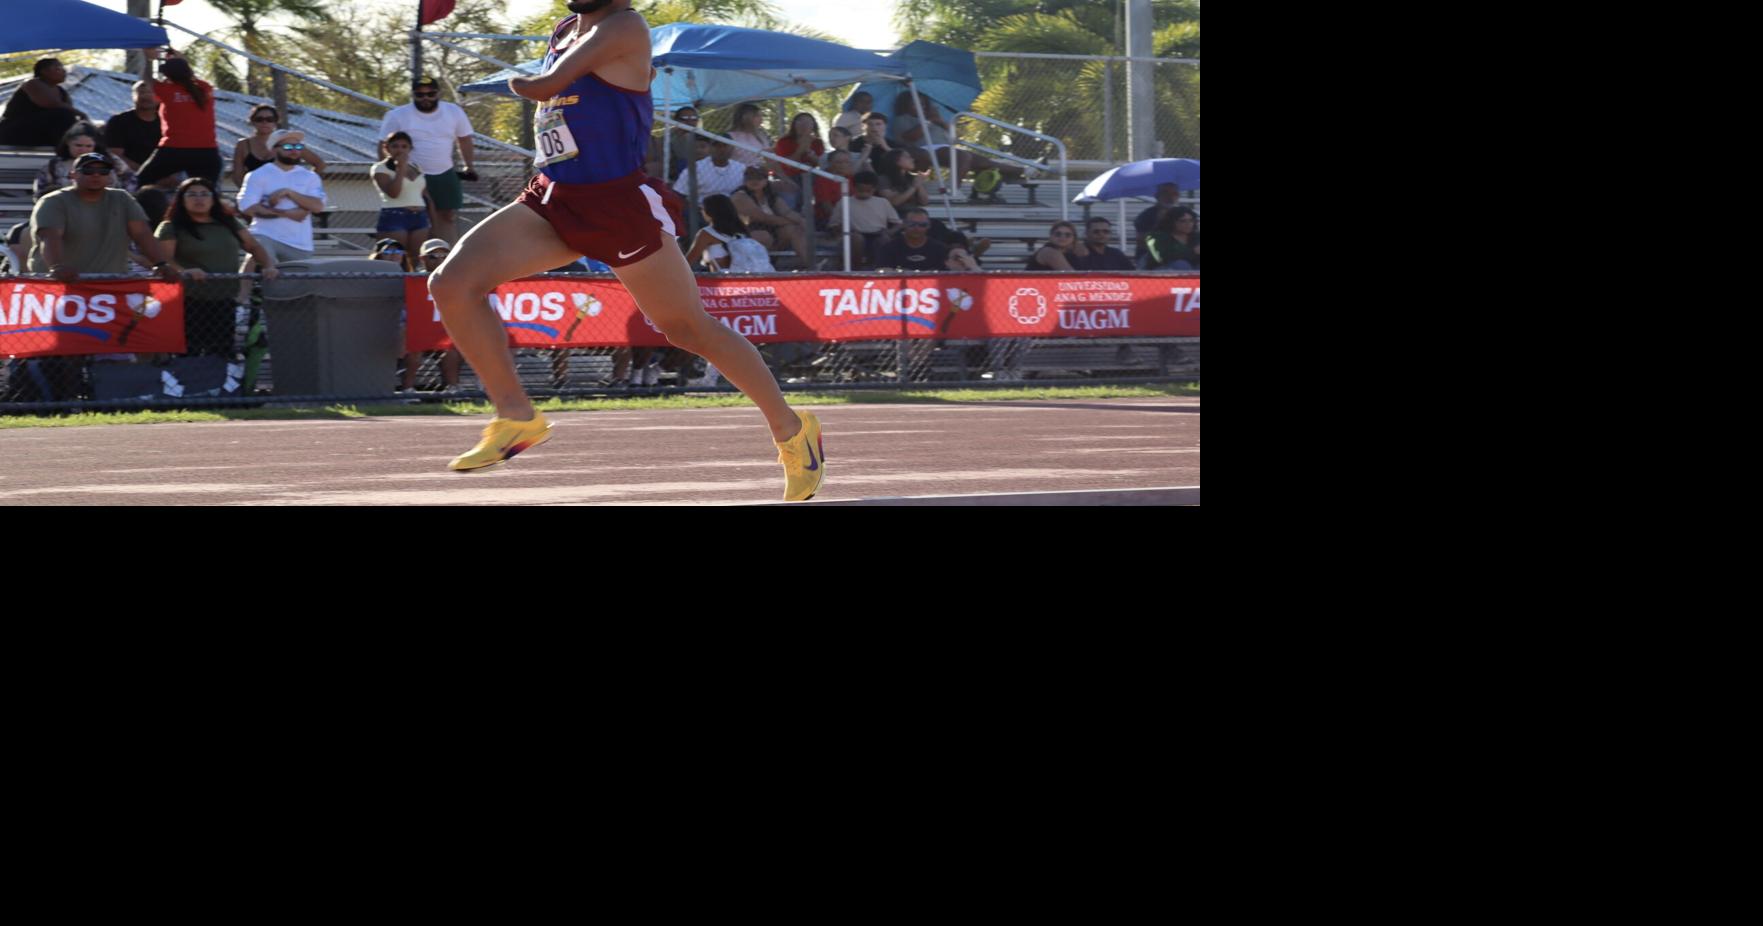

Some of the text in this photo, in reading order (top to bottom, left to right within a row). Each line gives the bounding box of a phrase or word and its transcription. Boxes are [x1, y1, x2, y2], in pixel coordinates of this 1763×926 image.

[698, 286, 775, 297] UNIVERSIDAD
[1057, 281, 1129, 291] UNIVERSIDAD
[819, 281, 940, 316] TAÍNOS
[1054, 293, 1077, 302] ANA
[1088, 291, 1133, 302] MÉNDEZ
[702, 298, 717, 308] NA
[1058, 309, 1130, 330] UAGM
